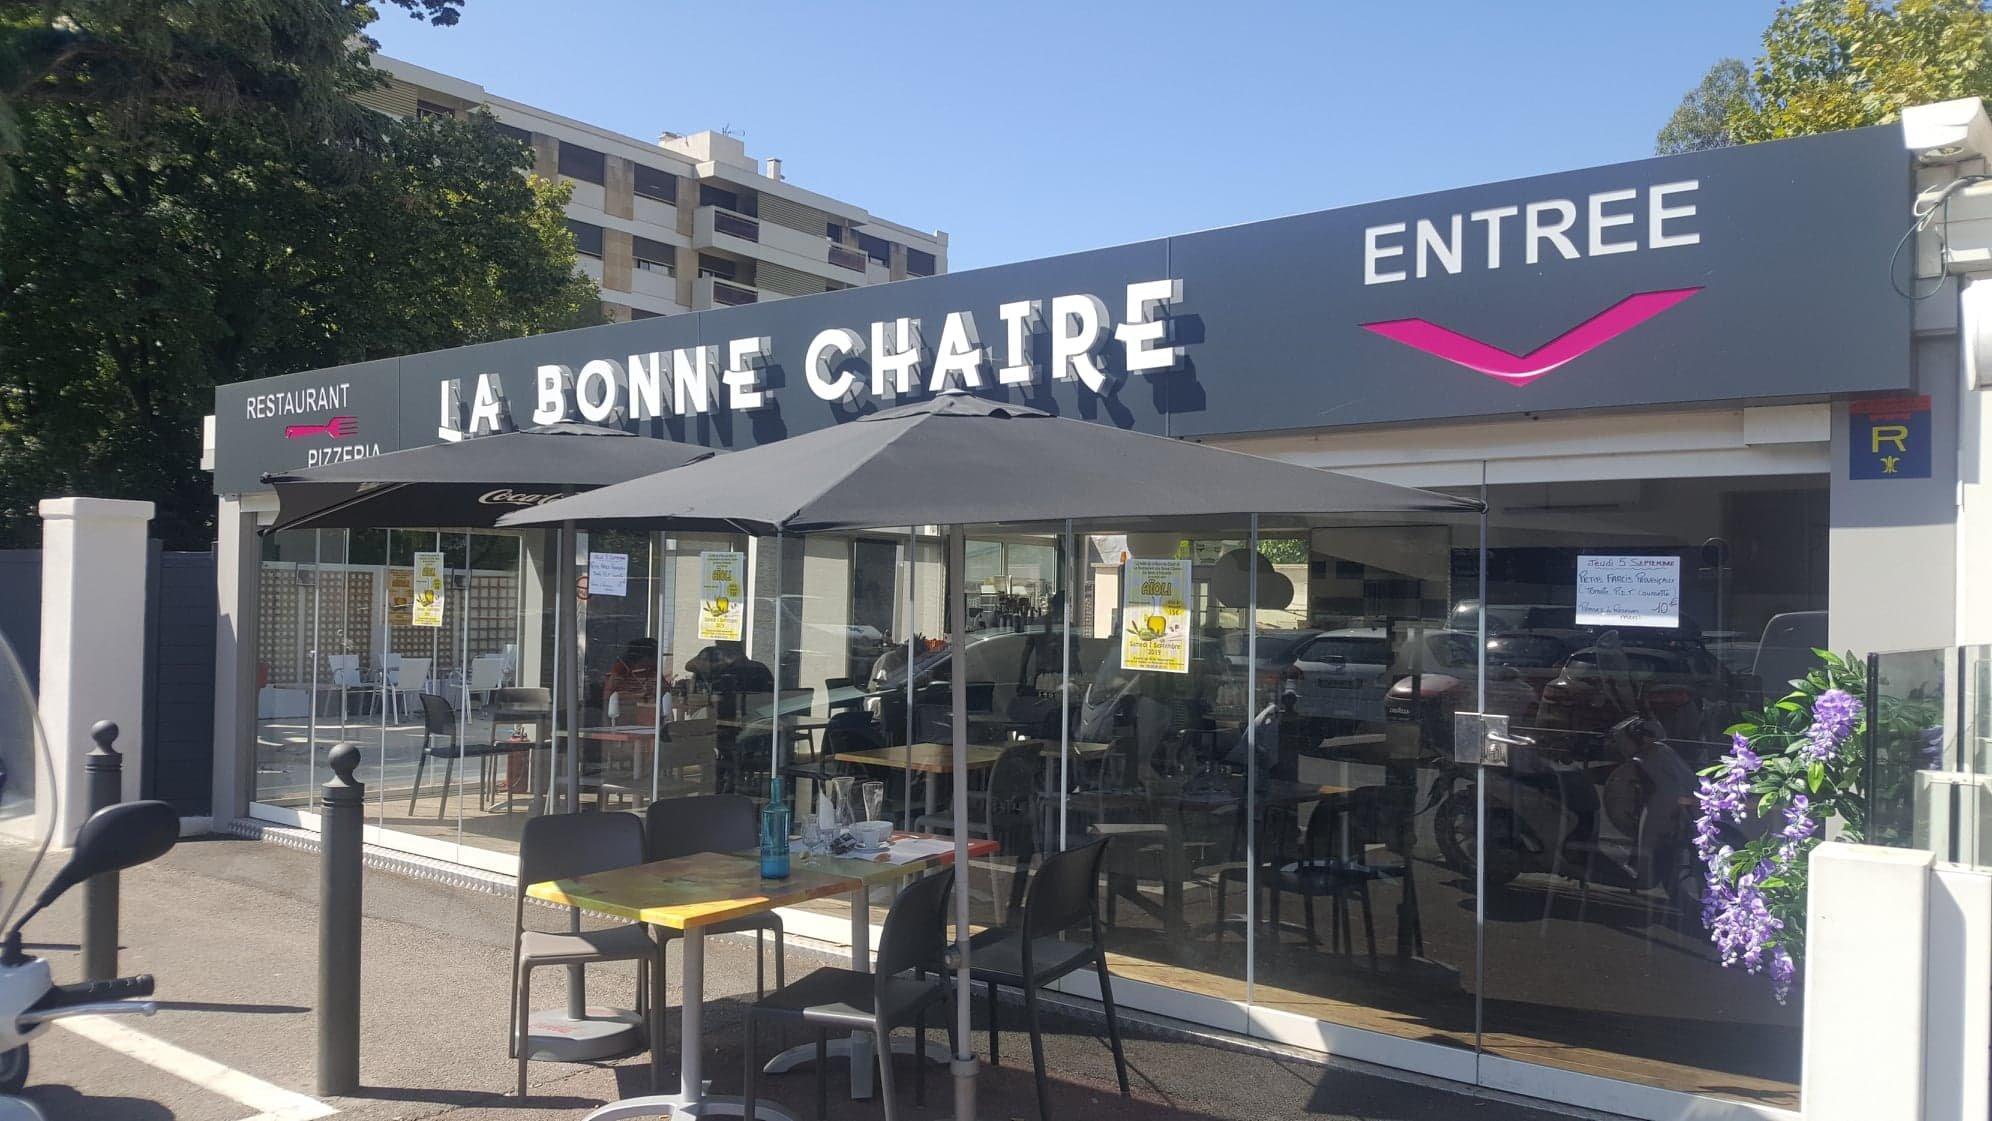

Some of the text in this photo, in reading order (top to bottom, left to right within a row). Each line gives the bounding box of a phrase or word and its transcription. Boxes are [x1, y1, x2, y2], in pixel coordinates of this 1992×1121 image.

[1363, 179, 1701, 286] ENTREE
[438, 278, 1177, 442] LA BONNE CHAIRE
[246, 383, 350, 420] RESTAURANT
[1871, 425, 1908, 453] R
